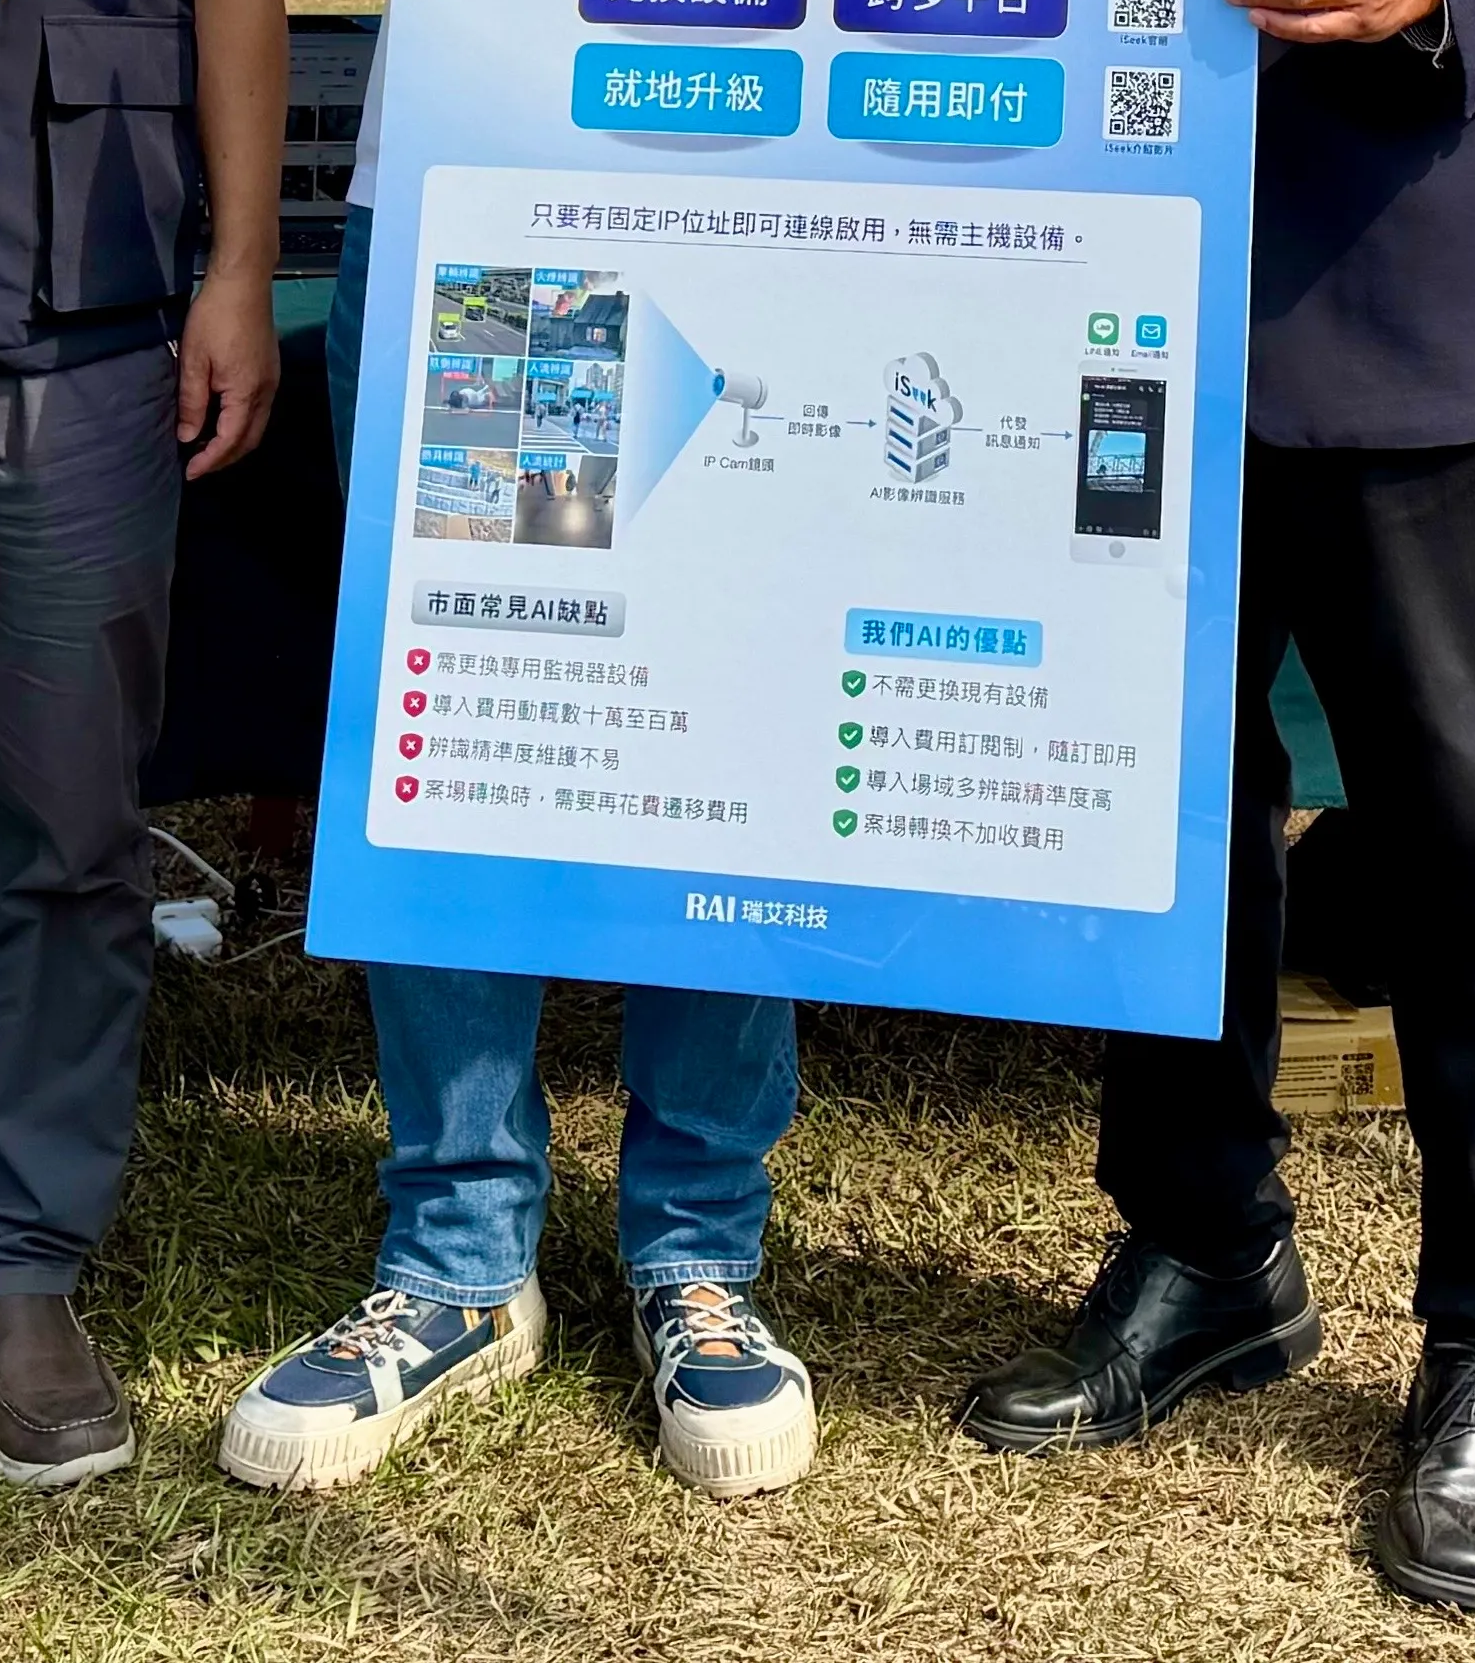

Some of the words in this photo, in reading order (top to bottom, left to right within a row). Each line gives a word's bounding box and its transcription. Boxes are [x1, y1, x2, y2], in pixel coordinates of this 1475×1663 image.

[603, 68, 765, 115] 就地升級
[862, 78, 1029, 124] 隨用即付
[529, 201, 1085, 254] 只要有固定IP位址即可連線啟用，無需主機設備。
[787, 421, 842, 439] 即時影像
[985, 434, 1041, 451] 訊息通知
[703, 455, 716, 468] IP
[869, 486, 965, 506] AI影像辨識服務
[426, 589, 609, 627] 市面常見AI缺點
[861, 618, 1028, 657] 我們AI的優點
[436, 651, 650, 689] 需更換專用監視器設備
[871, 673, 1049, 710] 不需更換現有設備
[431, 692, 690, 734] 導入費用動輒數十萬至百萬
[427, 735, 621, 771] 辨識精準度維護不易
[868, 724, 1138, 769] 導入費用訂閱制，隨訂即用
[423, 778, 749, 825] 案場轉換時，需要再花費遷移費用
[865, 768, 1114, 812] 導入場域多辨識精準度高
[863, 812, 1065, 852] 案場轉換不加收費用
[685, 892, 736, 923] RAI
[740, 899, 829, 930] 瑞艾科技
